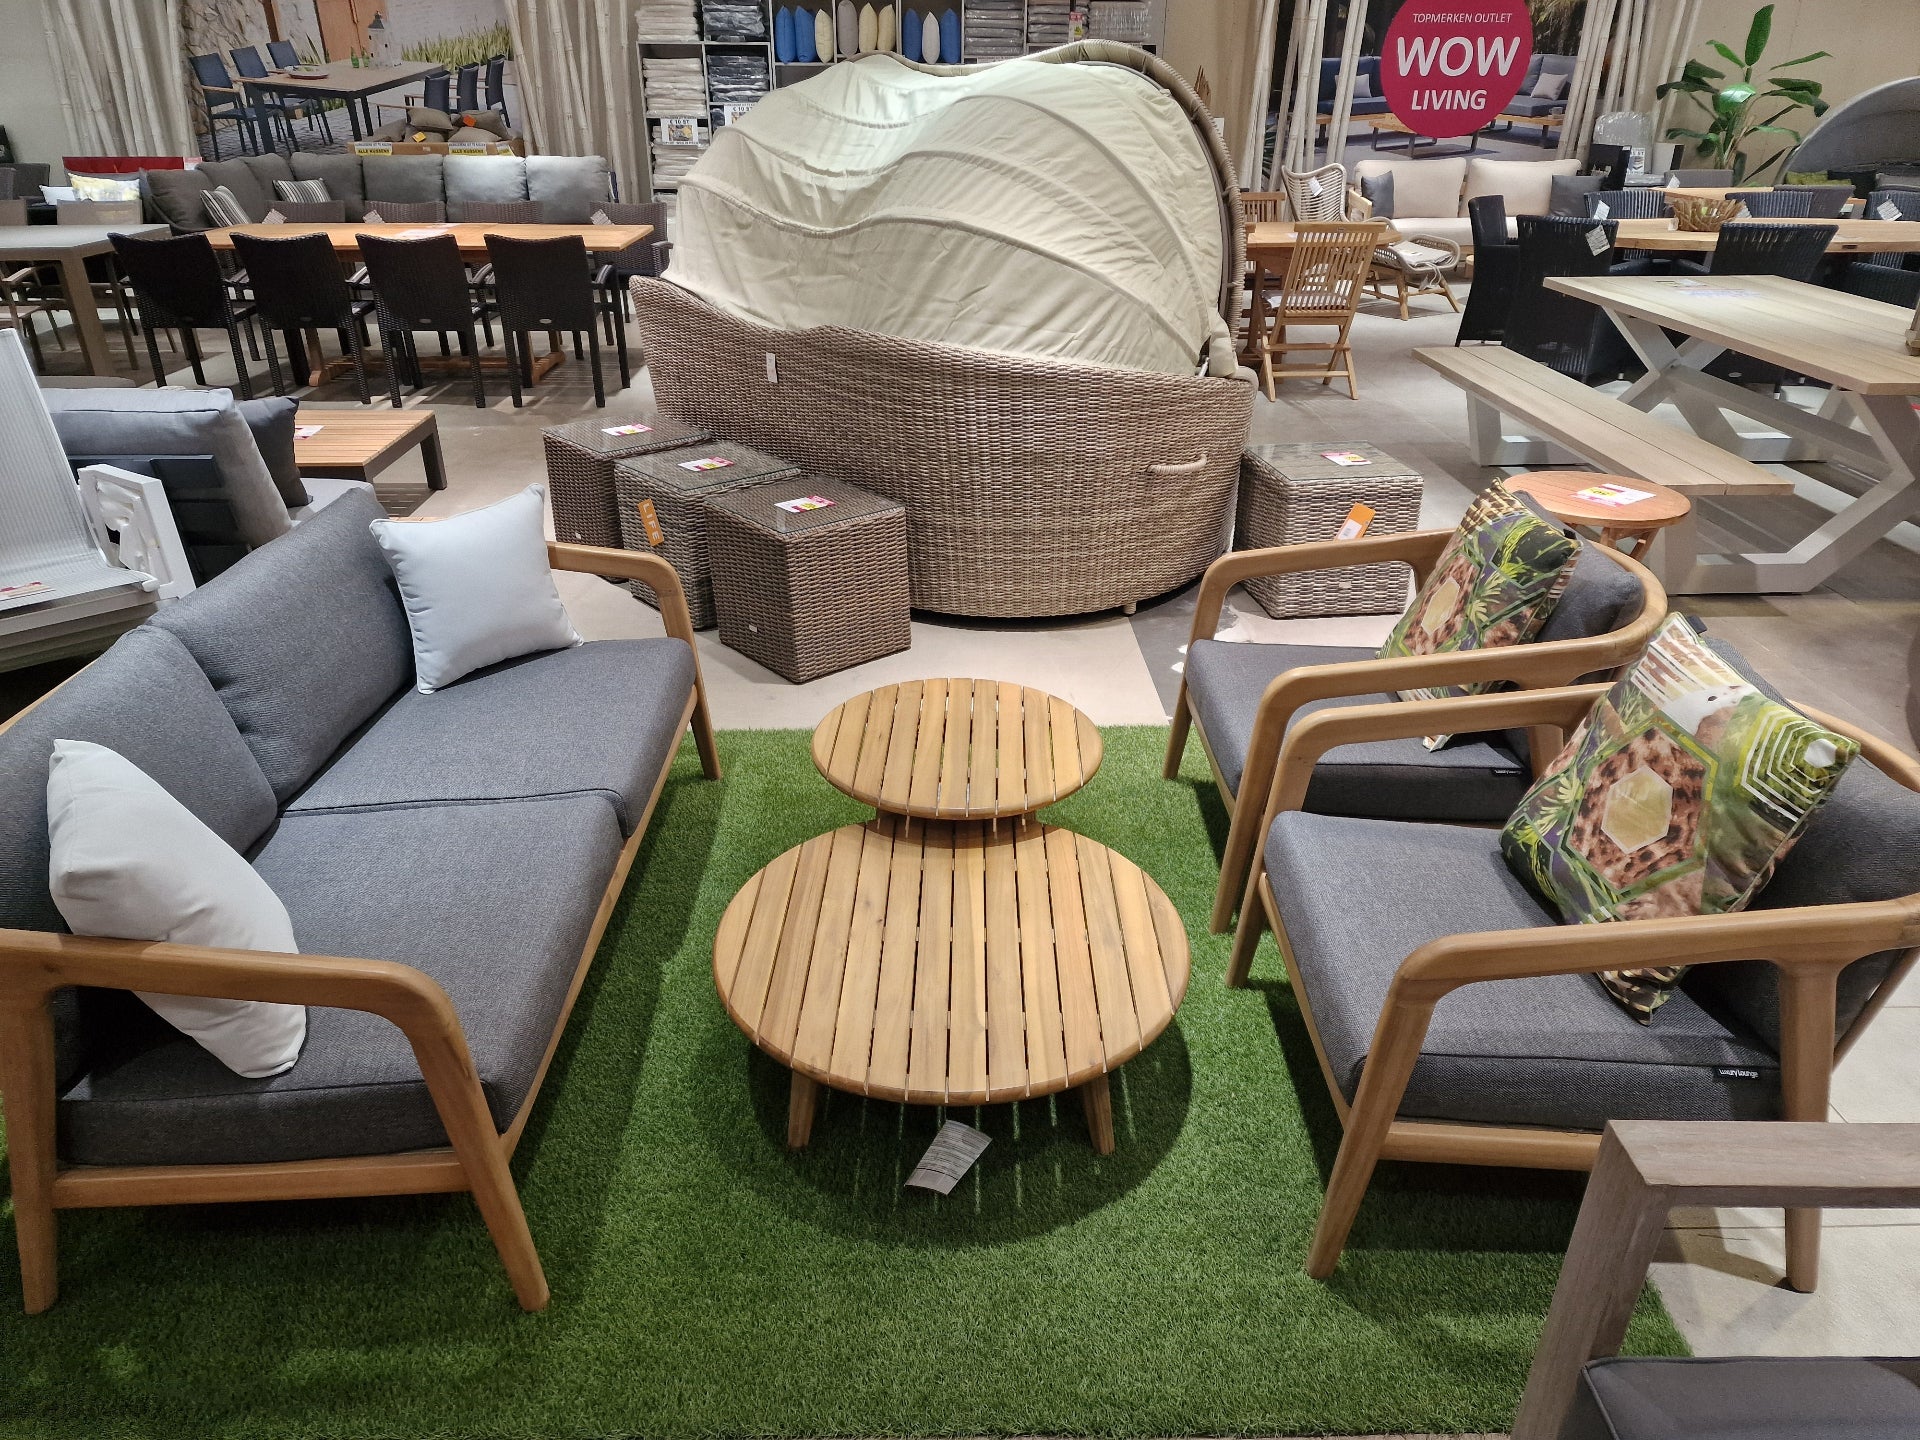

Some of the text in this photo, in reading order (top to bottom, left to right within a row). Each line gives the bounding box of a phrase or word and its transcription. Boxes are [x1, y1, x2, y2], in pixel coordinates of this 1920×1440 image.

[1412, 13, 1512, 23] TOPMERKEN OUTLET
[1397, 36, 1521, 77] WOW
[1411, 89, 1488, 111] LIVING
[642, 502, 660, 541] LIFE
